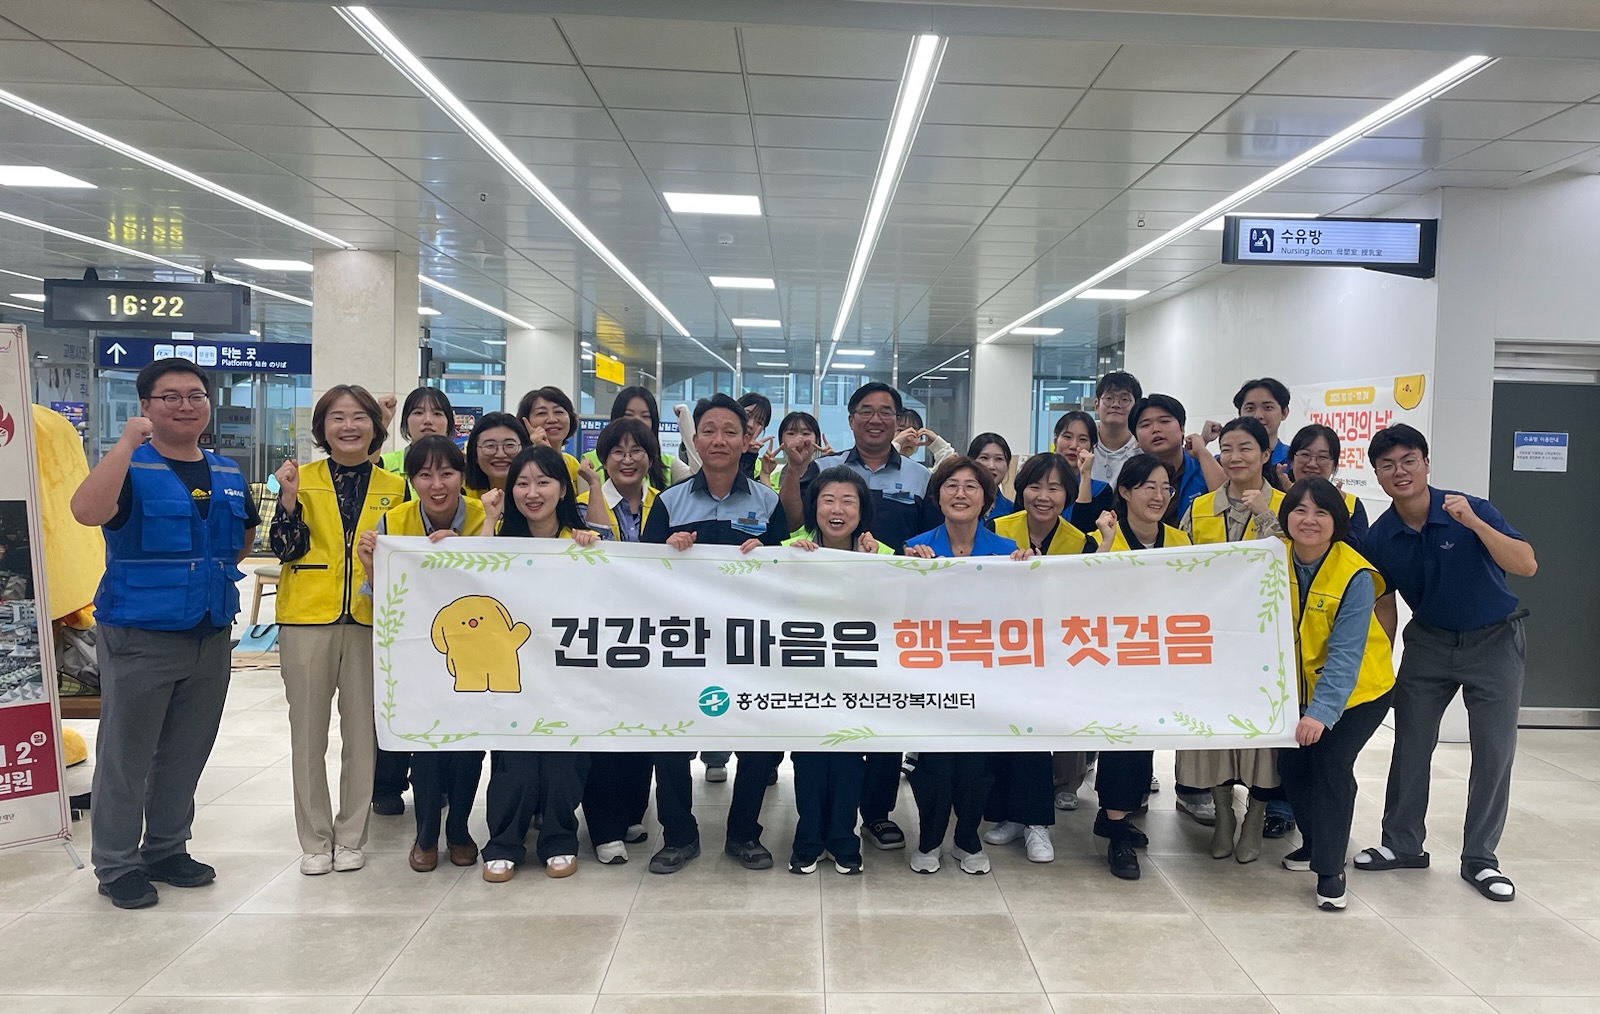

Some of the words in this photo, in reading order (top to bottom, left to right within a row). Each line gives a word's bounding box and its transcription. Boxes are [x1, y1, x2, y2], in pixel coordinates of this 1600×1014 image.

[1281, 229, 1322, 245] 수유방
[1281, 247, 1310, 256] Nursing
[1311, 248, 1333, 256] Room
[107, 294, 184, 317] 16:22
[221, 347, 242, 360] 타는
[246, 347, 257, 360] 곳
[221, 359, 252, 367] Platforms
[580, 420, 602, 430] 알림판
[551, 616, 711, 668] 건강한
[726, 617, 879, 668] 마음은
[893, 617, 1045, 669] 행복의
[1061, 614, 1214, 667] 첫걸음
[736, 692, 837, 710] 홍성군보건소
[842, 692, 976, 710] 정신건강복지센터
[33, 733, 44, 744] 일
